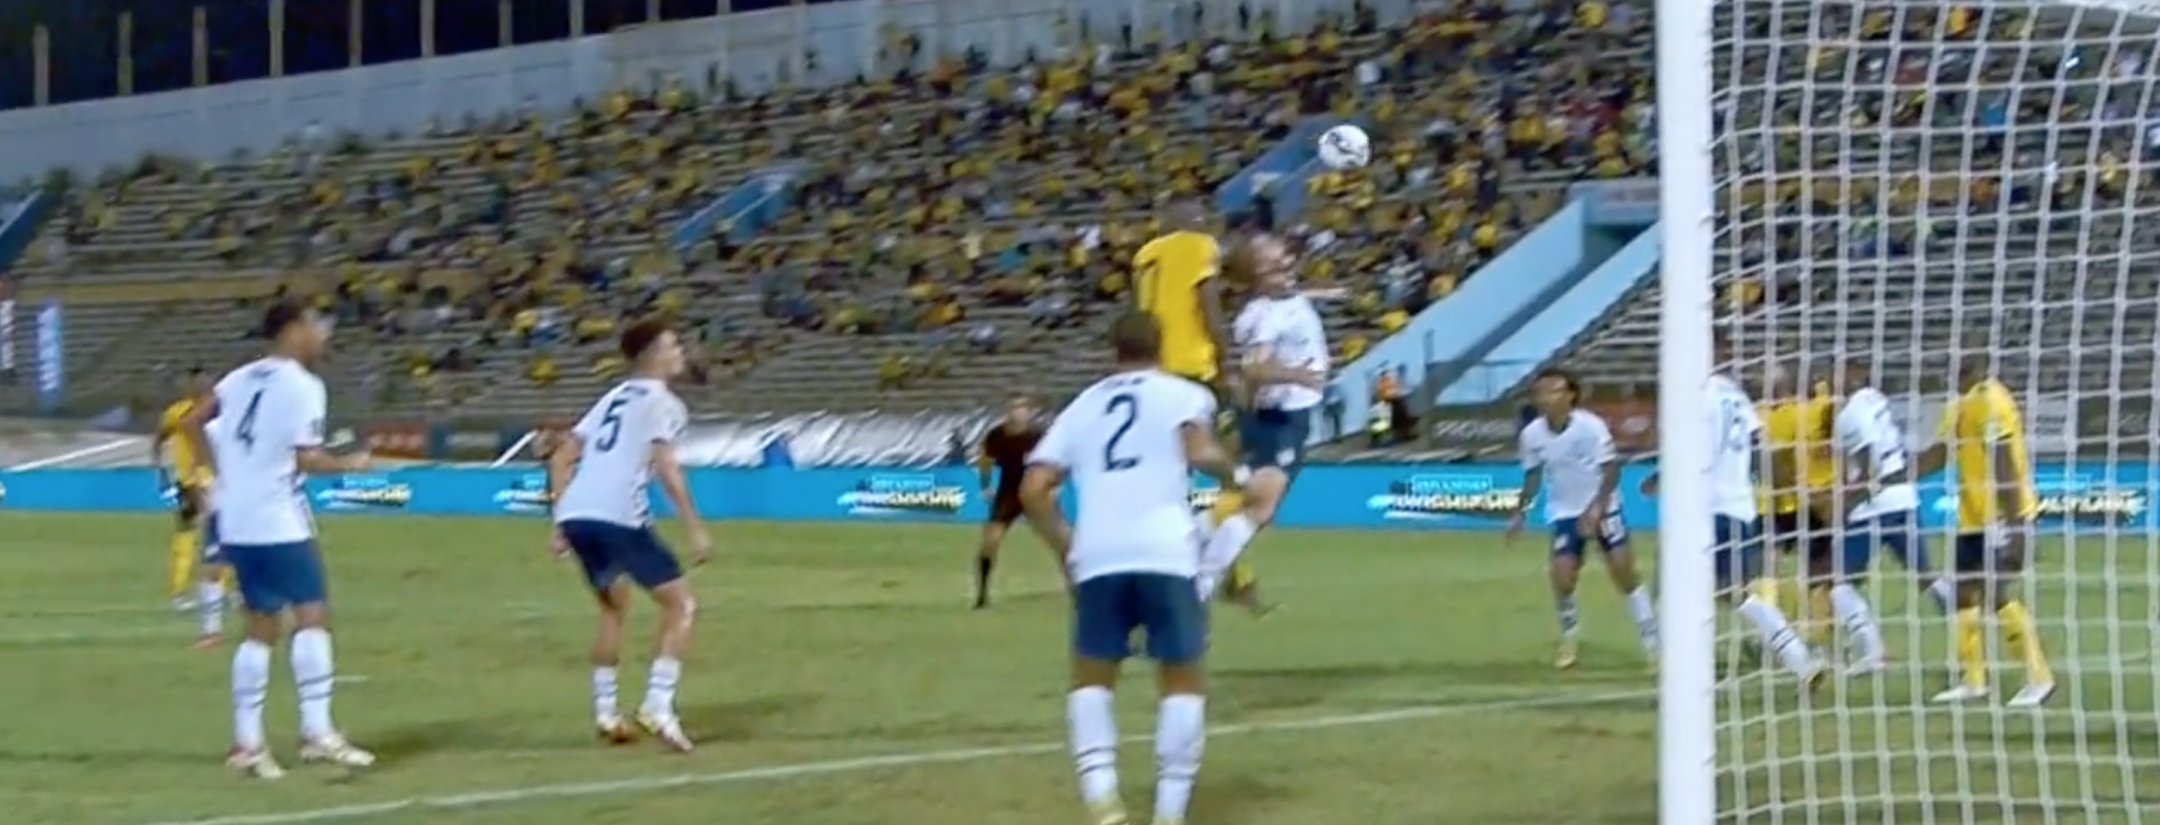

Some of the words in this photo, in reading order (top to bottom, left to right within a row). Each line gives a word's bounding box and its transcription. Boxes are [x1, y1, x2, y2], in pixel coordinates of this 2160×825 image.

[235, 388, 264, 454] 4
[595, 399, 628, 453] 5
[1104, 393, 1142, 472] 2
